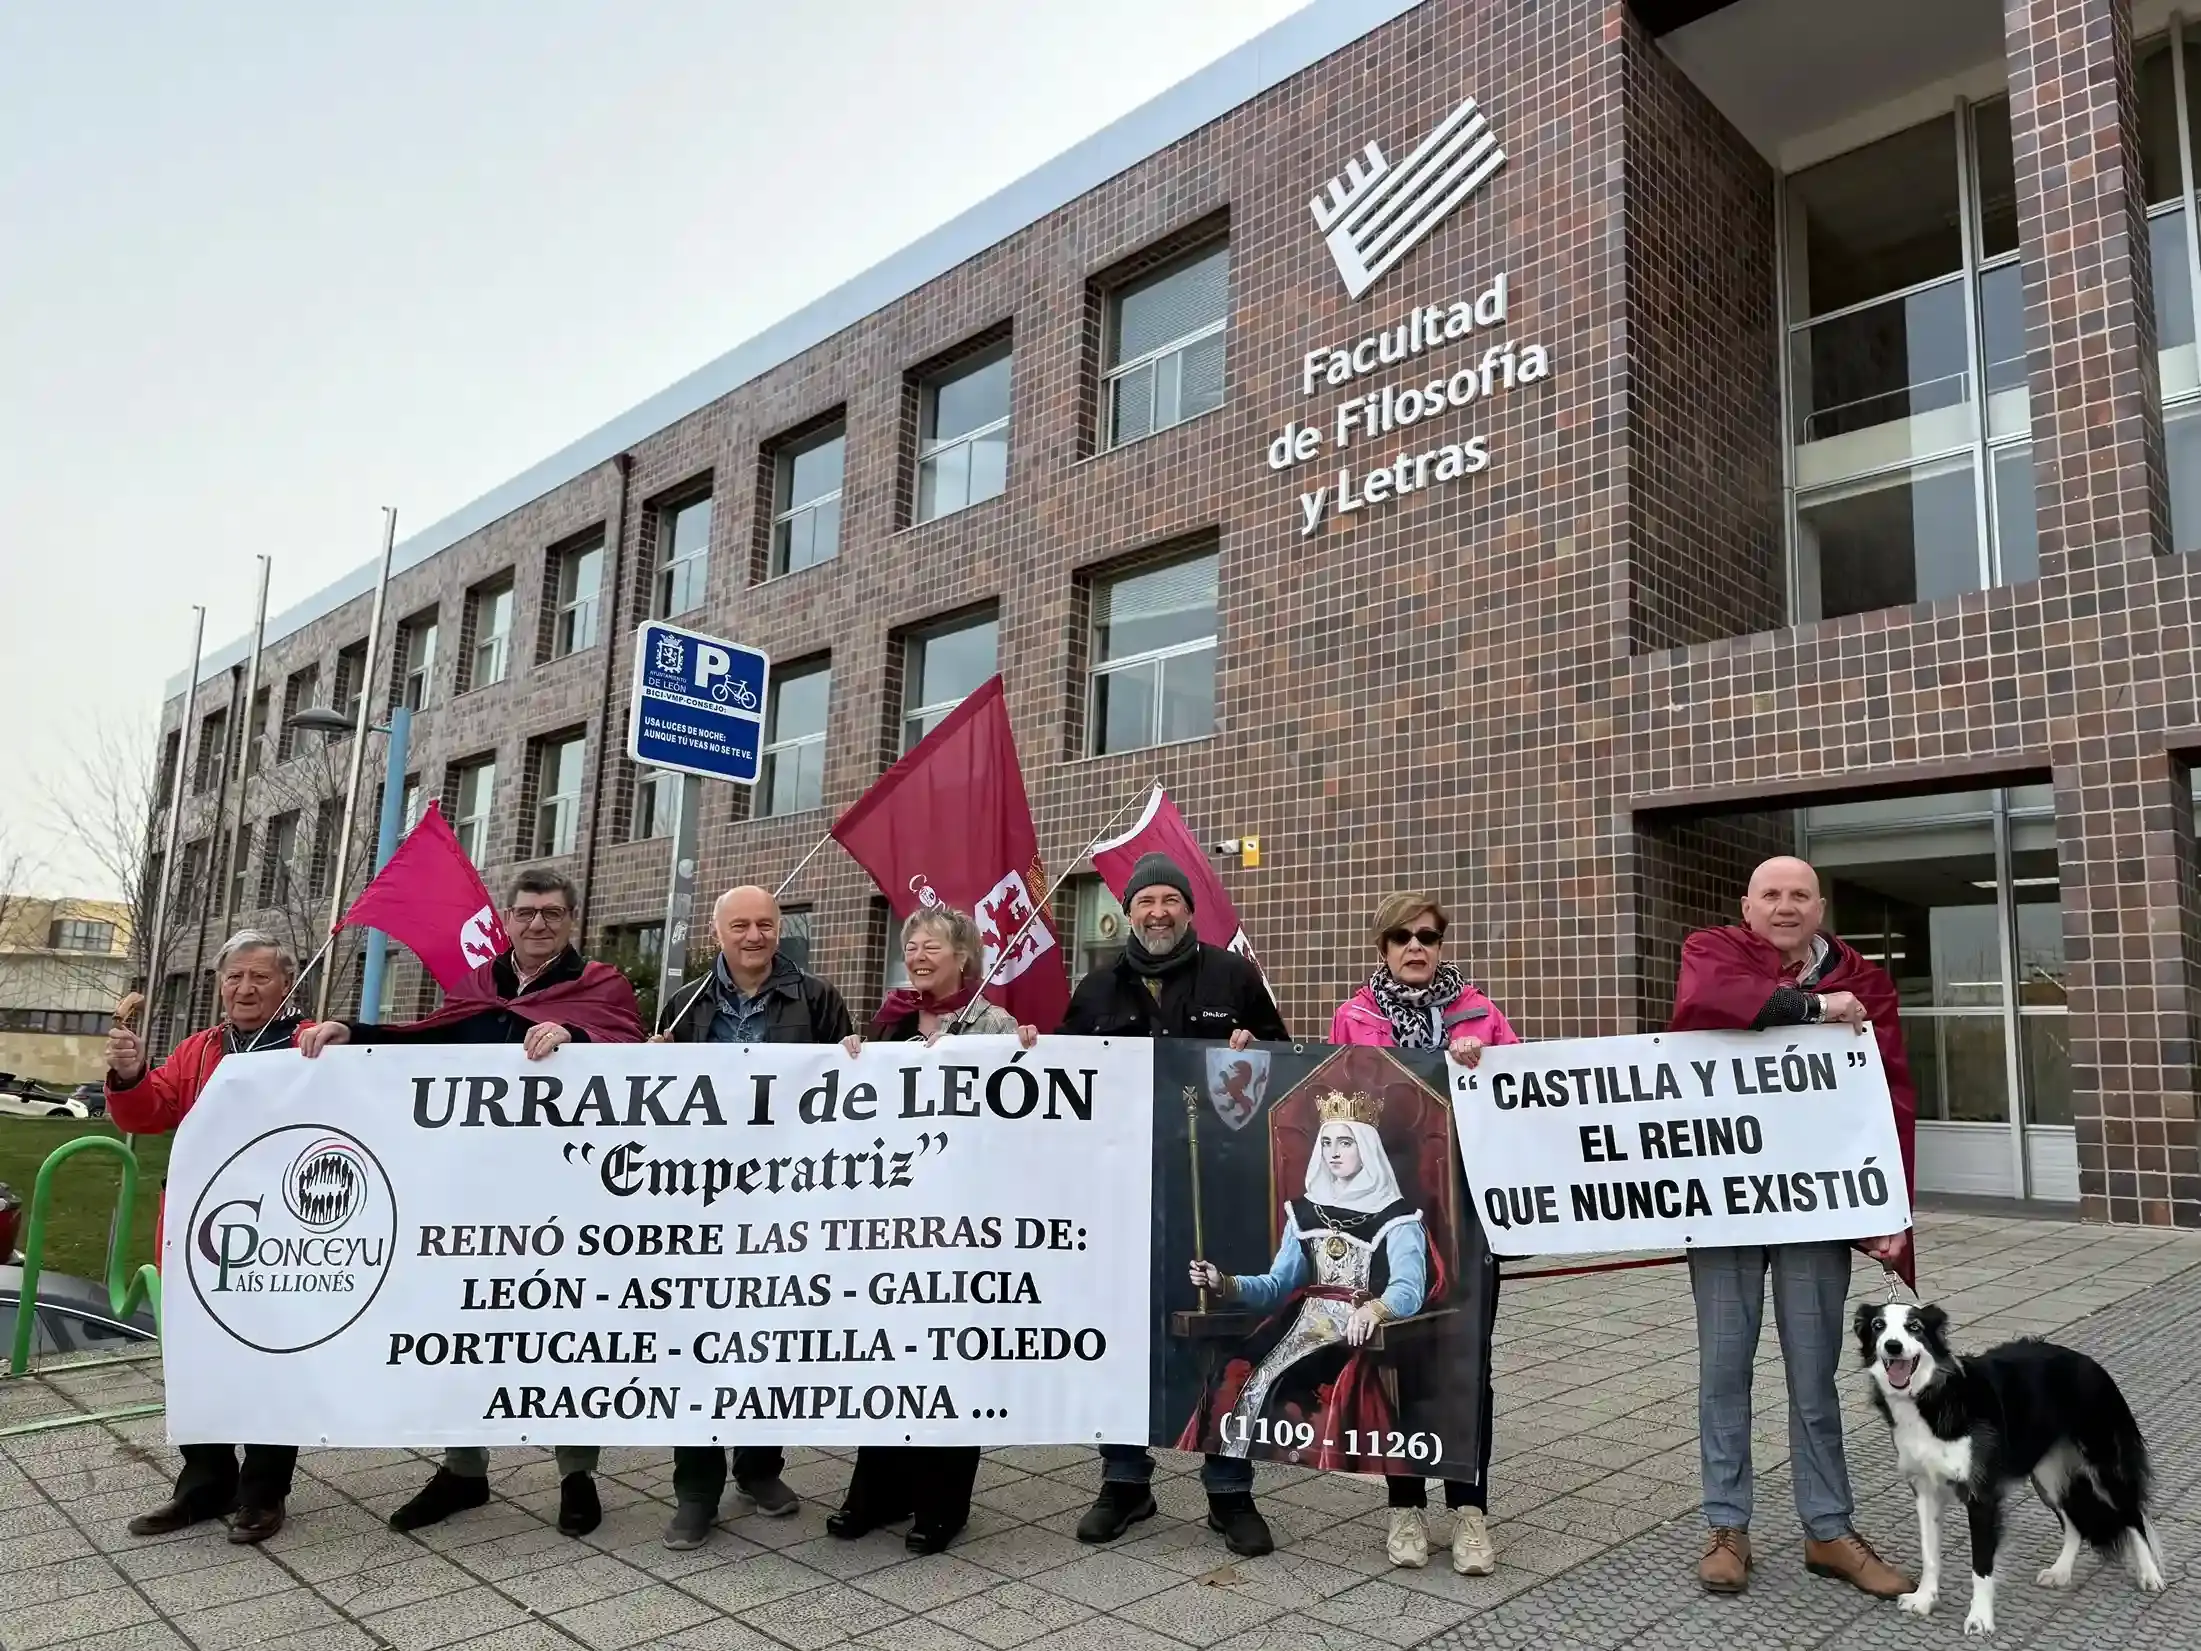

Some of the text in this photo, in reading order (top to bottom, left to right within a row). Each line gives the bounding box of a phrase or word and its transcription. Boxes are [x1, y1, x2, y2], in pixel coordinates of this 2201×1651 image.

[1302, 272, 1508, 396] Facultad
[1268, 340, 1550, 470] de Filosofía
[1300, 434, 1490, 536] y Letras
[648, 677, 687, 693] DE LEÓN
[695, 643, 731, 688] P
[644, 716, 661, 727] USA
[661, 720, 687, 733] LUCES
[687, 725, 698, 736] DE
[644, 729, 753, 760] AUNQUE TÚ VEAS NO SE TE VE.
[411, 1050, 1099, 1129] URRAKA I de LEÓN
[1492, 1062, 1683, 1111] CASTILLA
[1690, 1059, 1717, 1098] Y
[1731, 1043, 1838, 1095] LEÓN
[1578, 1114, 1763, 1163] EL REINO
[1484, 1156, 1889, 1231] QUE NUNCA EXISTIÓ
[416, 1215, 1087, 1257] REINÓ SOBRE LAS TIERRAS DE:
[269, 1270, 355, 1292] LLIONÉS
[460, 1268, 586, 1310] LEÓN
[617, 1273, 831, 1310] ASTURIAS
[868, 1270, 1042, 1306] GALICIA
[385, 1331, 657, 1366] PORTUCALE
[692, 1328, 896, 1365] CASTILLA
[927, 1326, 1107, 1362] TOLEDO
[482, 1376, 681, 1420] ARAGÓN
[710, 1385, 959, 1420] PAMPLONA
[1219, 1412, 1315, 1450] (1109
[1344, 1429, 1443, 1465] 1126)
